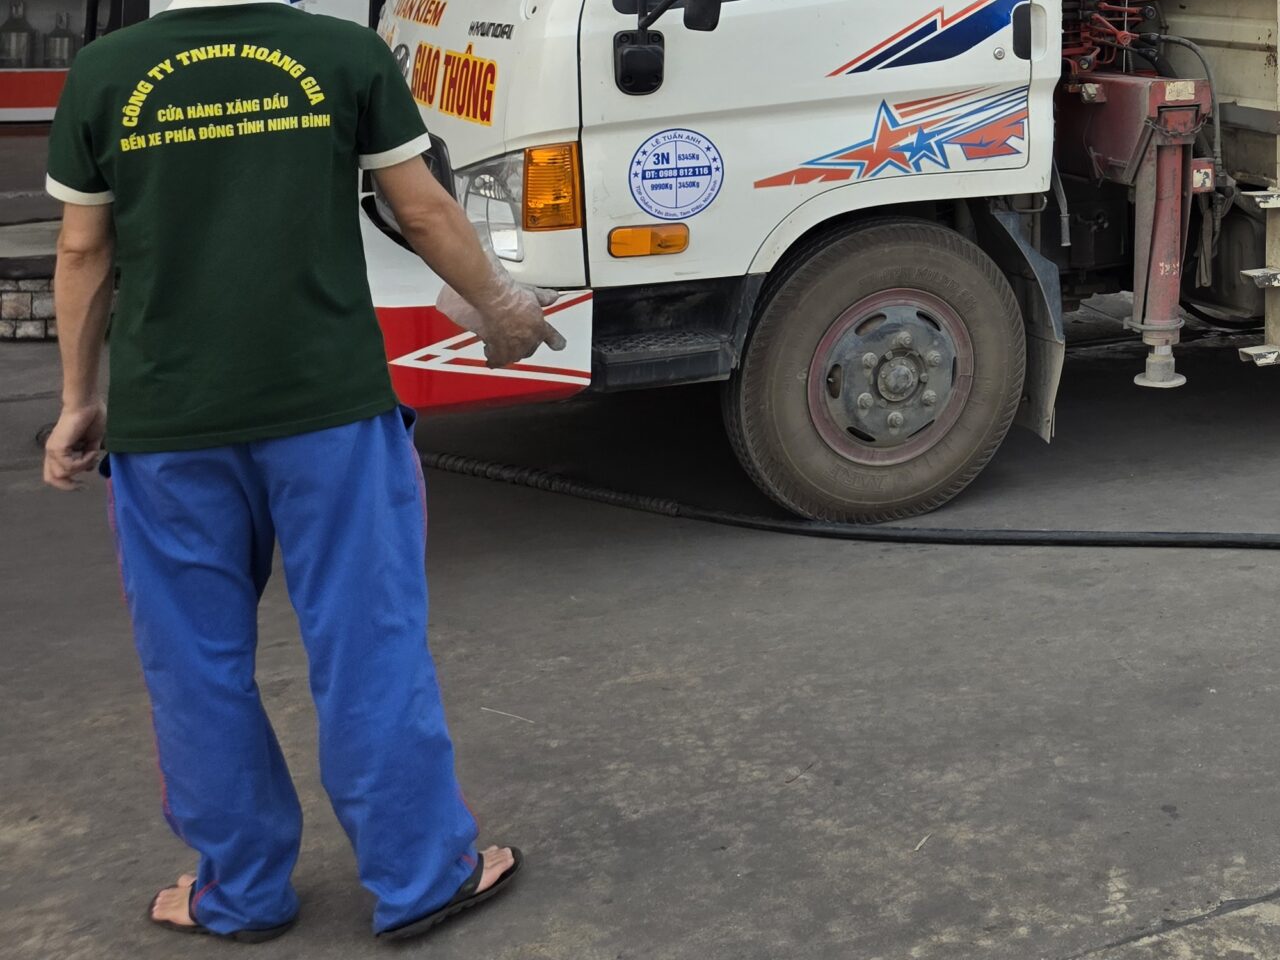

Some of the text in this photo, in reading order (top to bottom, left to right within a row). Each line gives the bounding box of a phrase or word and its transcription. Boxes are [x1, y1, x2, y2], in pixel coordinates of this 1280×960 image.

[122, 43, 325, 127] CÔNG TY TNHH HOÀNG GIA
[411, 41, 496, 125] GIAO THÔNG
[157, 104, 184, 122] CỬA
[187, 100, 222, 119] HÀNG
[226, 96, 260, 114] XĂNG
[121, 132, 146, 152] BẾN
[149, 132, 162, 146] XE
[165, 124, 196, 144] PHÍA
[198, 123, 234, 140] ĐÔNG
[268, 115, 299, 131] NINH
[301, 112, 331, 129] BÌNH
[653, 152, 670, 165] 3N
[659, 169, 678, 178] 0988
[679, 168, 693, 176] 812
[695, 167, 709, 175] 116
